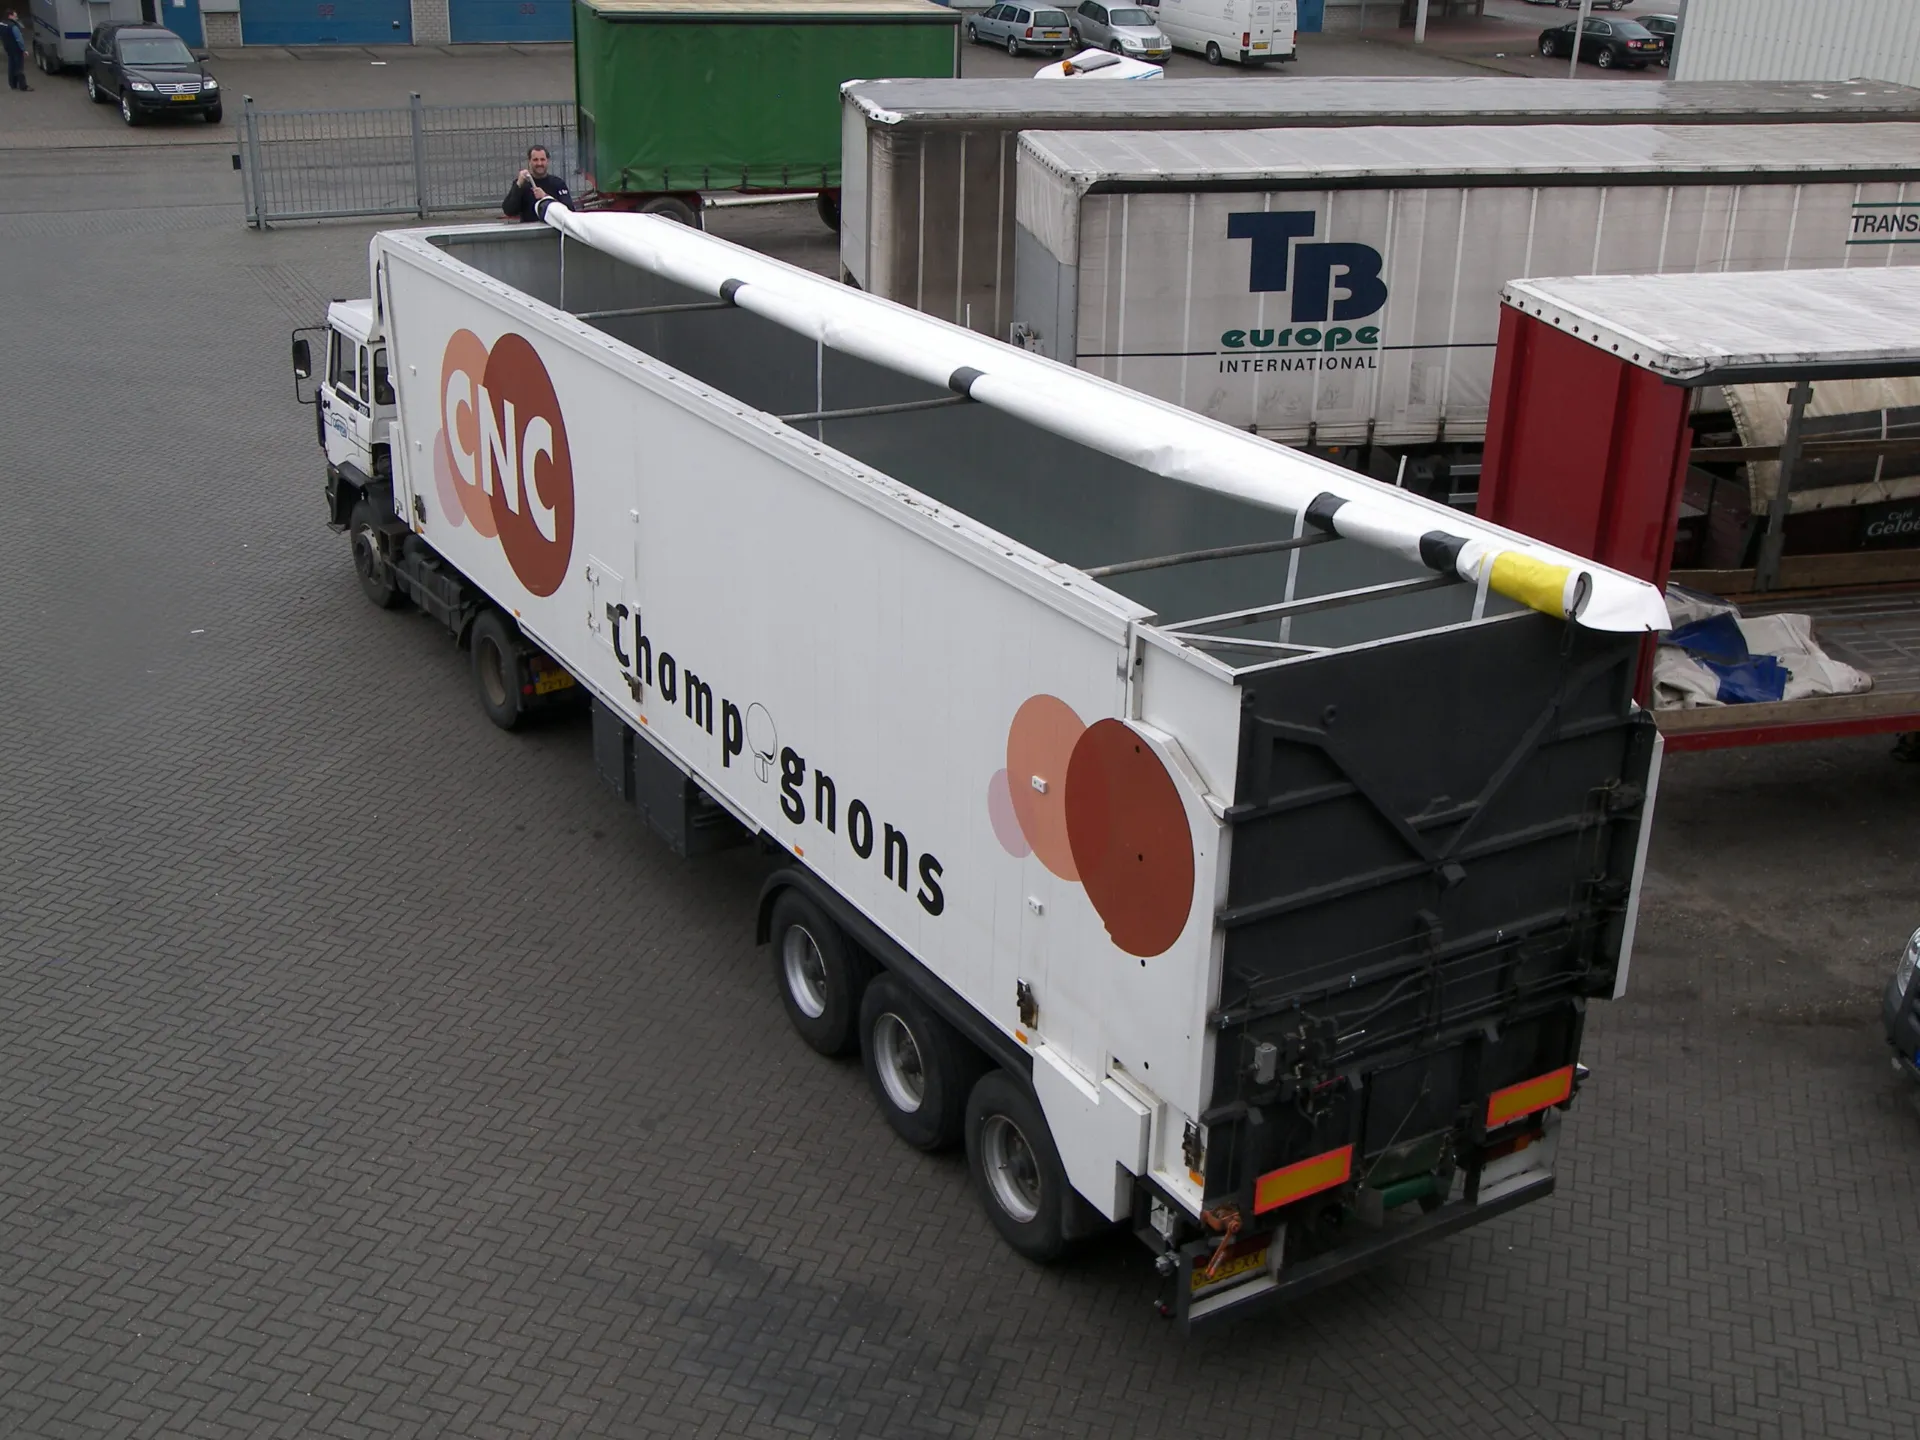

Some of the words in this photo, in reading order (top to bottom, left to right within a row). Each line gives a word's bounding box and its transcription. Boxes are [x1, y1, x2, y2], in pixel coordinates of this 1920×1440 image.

[1851, 214, 1920, 233] TRANS
[1227, 211, 1388, 322] TB
[1221, 326, 1380, 352] europe
[1219, 356, 1377, 373] INTERNATIONAL
[446, 369, 557, 542] CNC
